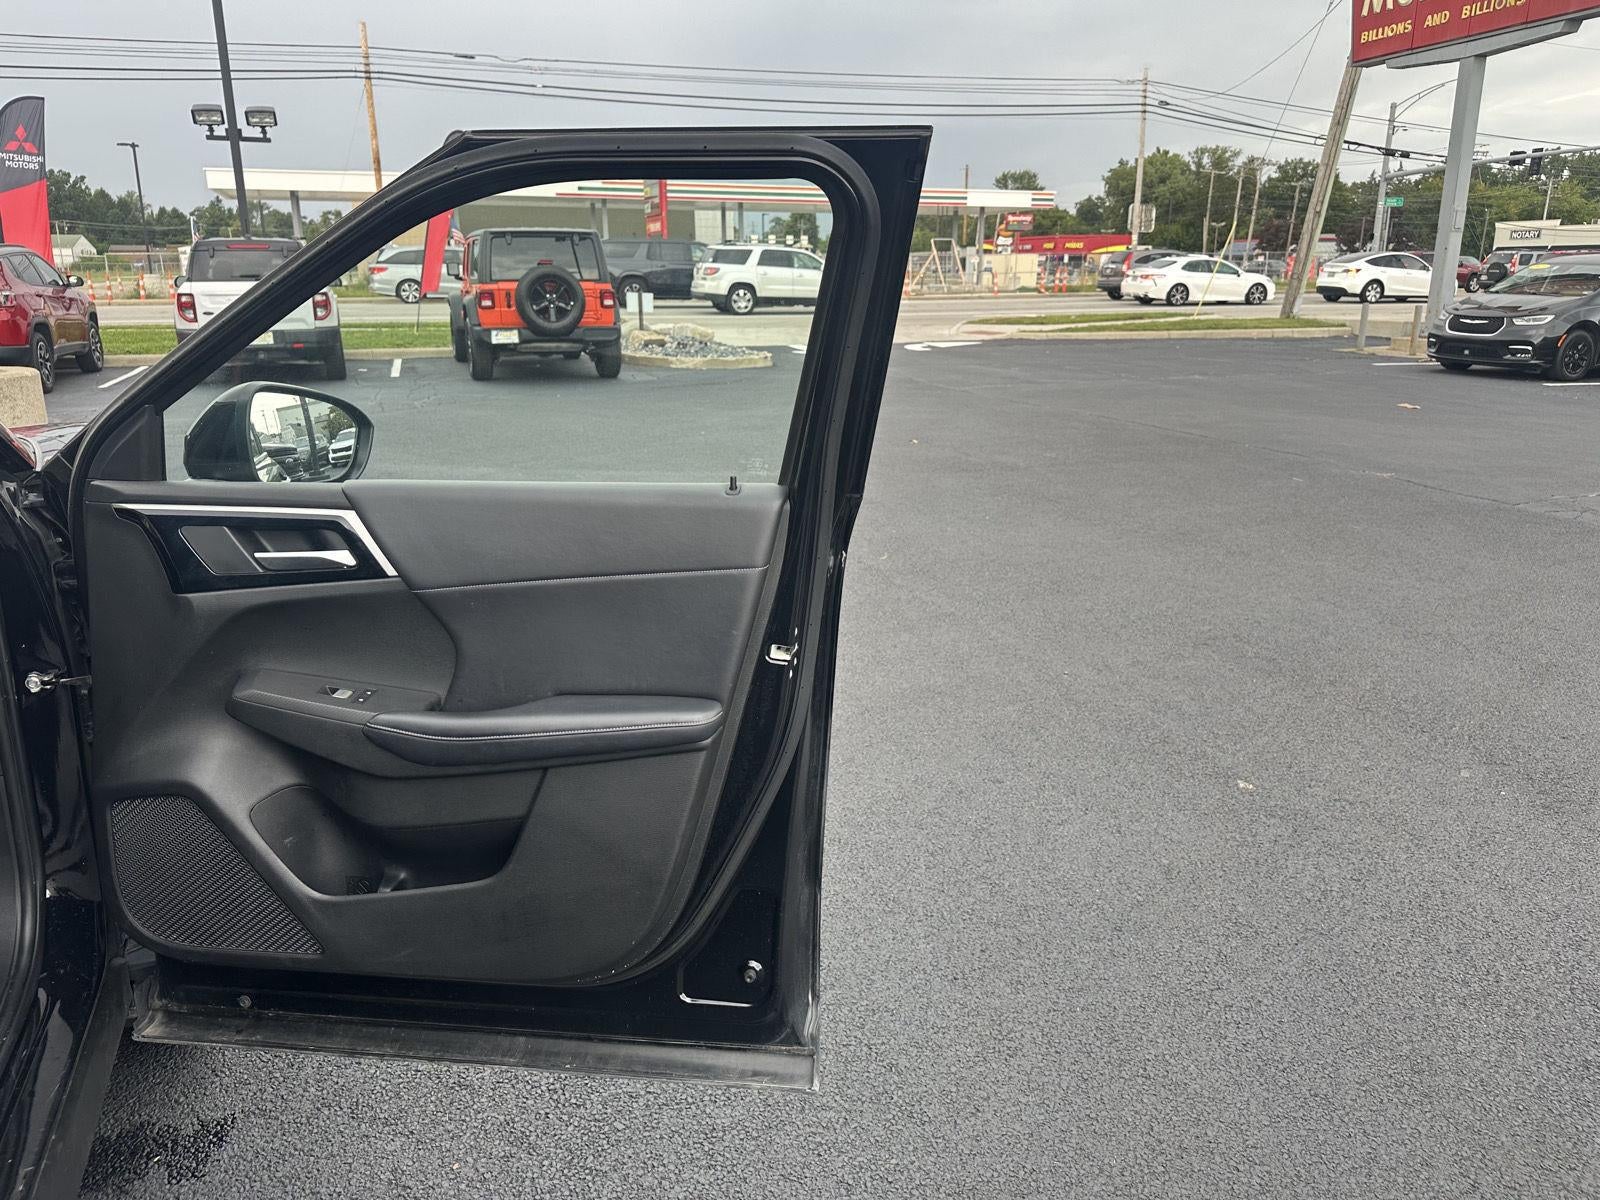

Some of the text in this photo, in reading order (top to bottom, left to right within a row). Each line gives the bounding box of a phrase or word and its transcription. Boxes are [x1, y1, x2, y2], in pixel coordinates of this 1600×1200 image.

[1360, 20, 1412, 43] BILLIONS
[1424, 11, 1450, 28] AND
[0, 153, 44, 163] MITSUBISHI
[5, 160, 39, 170] MOTORS
[1511, 230, 1540, 239] NOTARY
